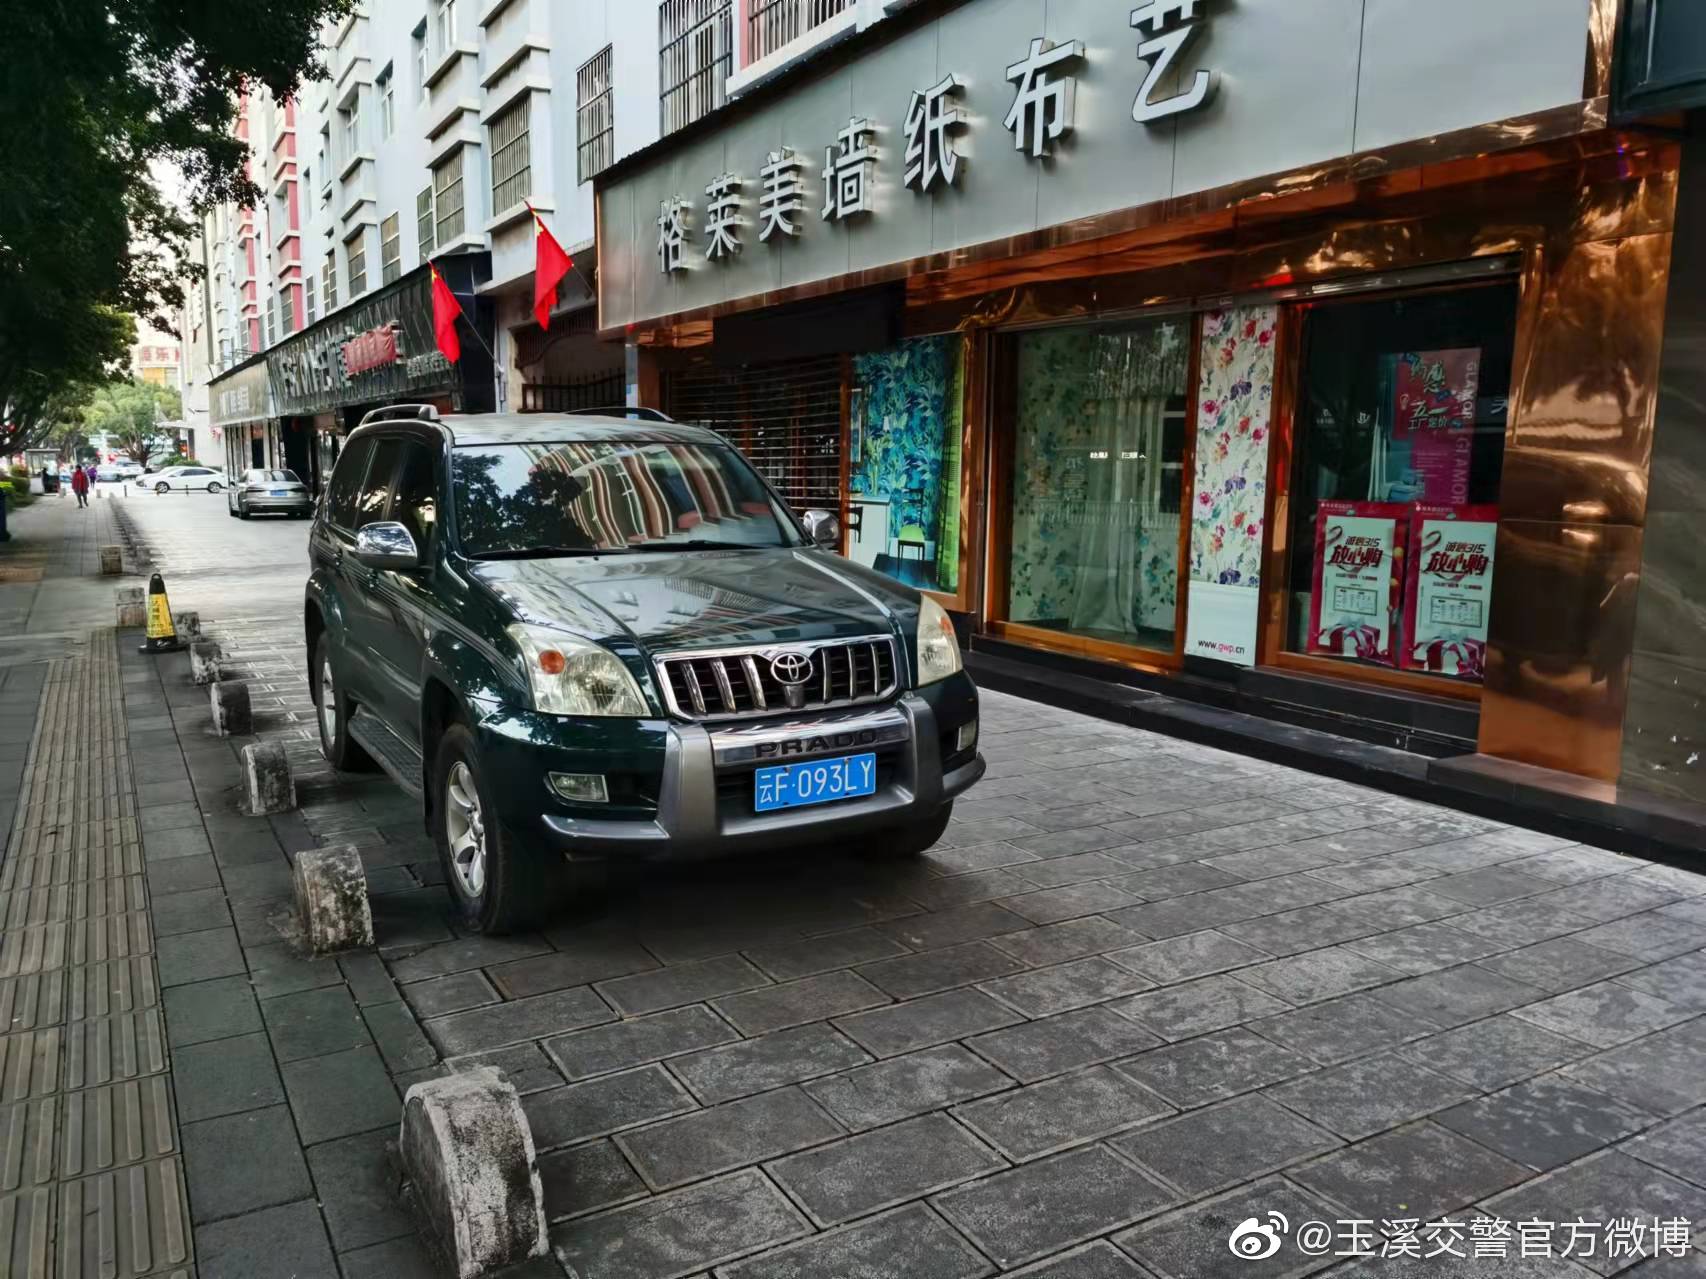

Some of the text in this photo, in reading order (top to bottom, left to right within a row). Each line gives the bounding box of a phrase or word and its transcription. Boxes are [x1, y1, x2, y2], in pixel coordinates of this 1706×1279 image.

[657, 0, 1213, 272] 格莱美墙纸布艺
[1409, 400, 1449, 418] 五一
[1345, 535, 1382, 547] 诚信315
[1445, 541, 1487, 554] 诚信315
[1328, 545, 1384, 569] 放心购
[1426, 551, 1490, 577] 放心购
[1198, 640, 1245, 655] www.gwp.cn
[755, 730, 878, 759] PRADO
